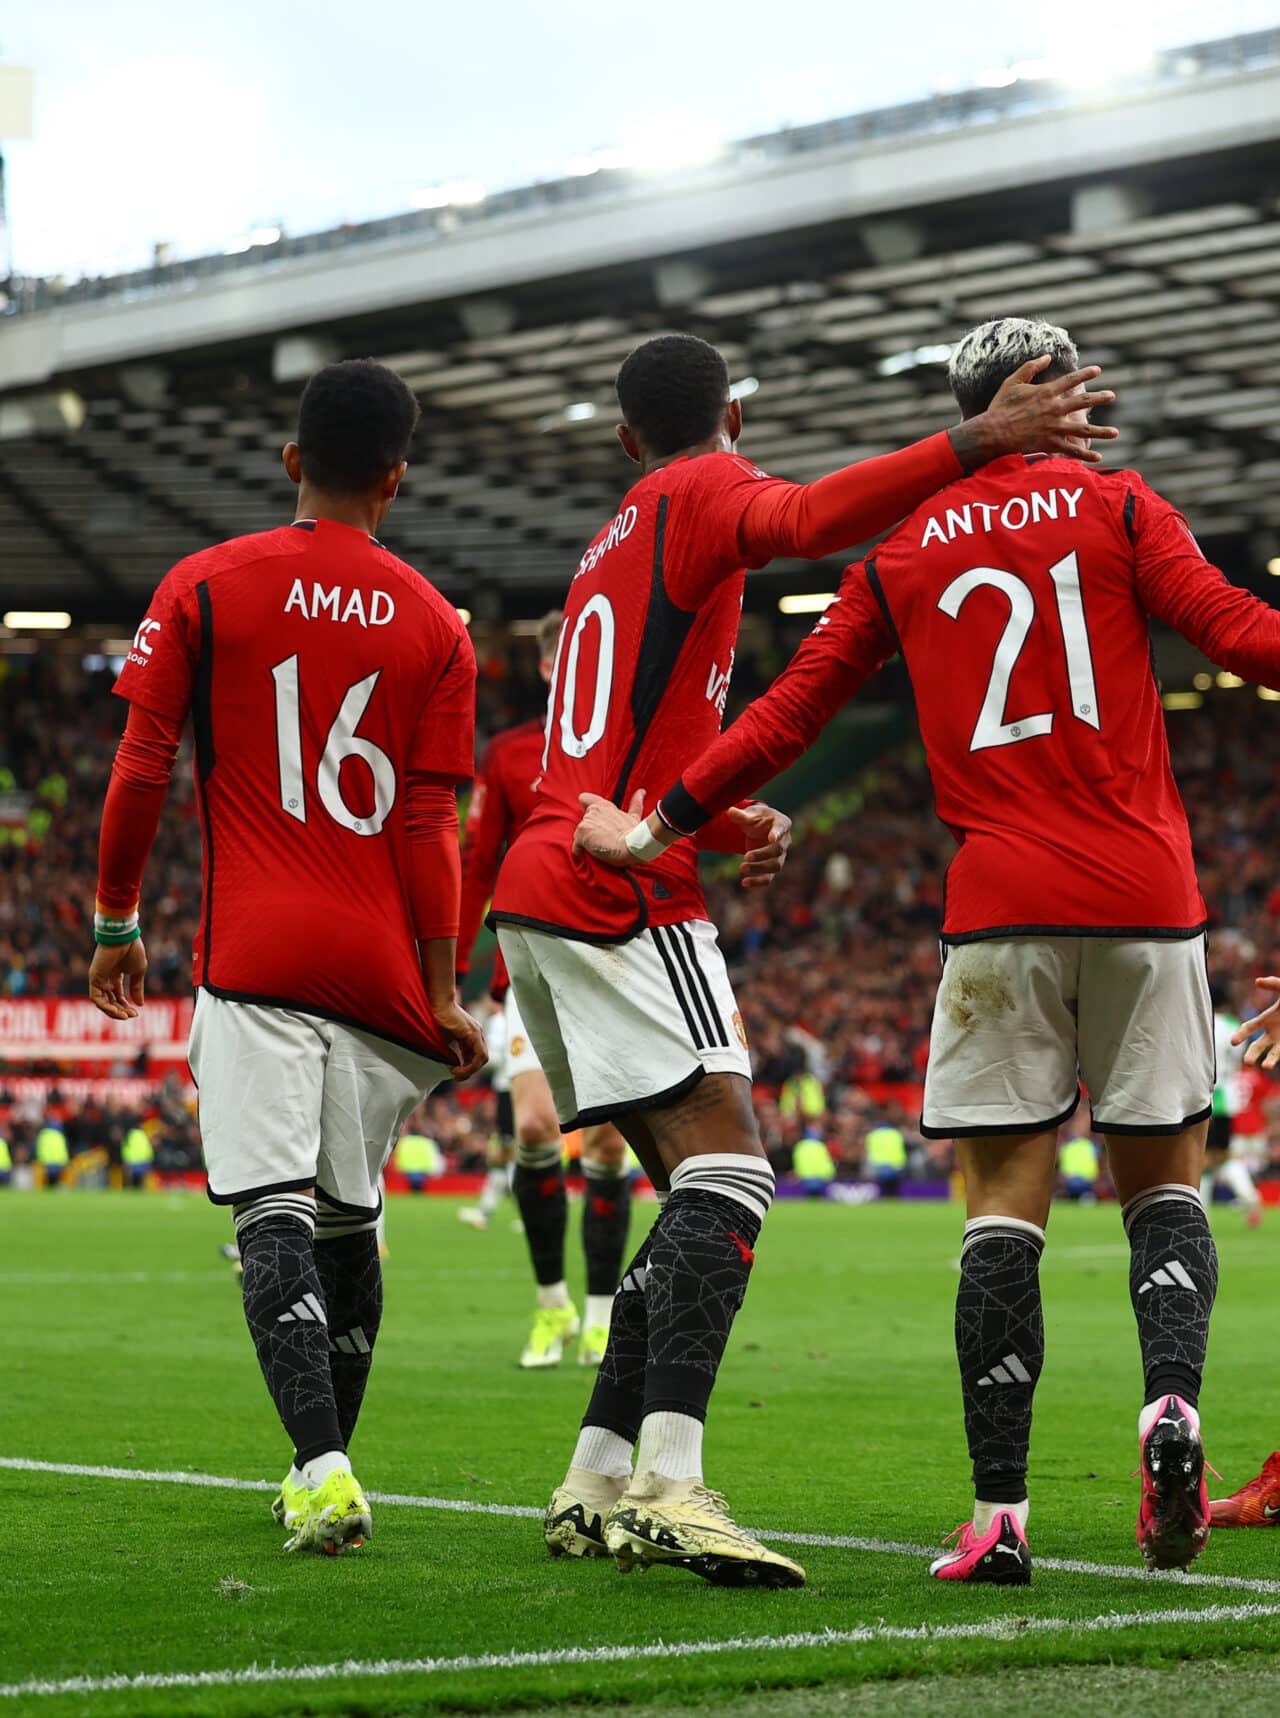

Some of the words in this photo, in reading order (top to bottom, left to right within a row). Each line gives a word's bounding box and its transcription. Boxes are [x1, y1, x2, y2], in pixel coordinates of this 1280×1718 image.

[921, 487, 1083, 548] ANTONY
[284, 578, 395, 628] AMAD
[937, 550, 1100, 752] 21
[271, 653, 396, 836] 16
